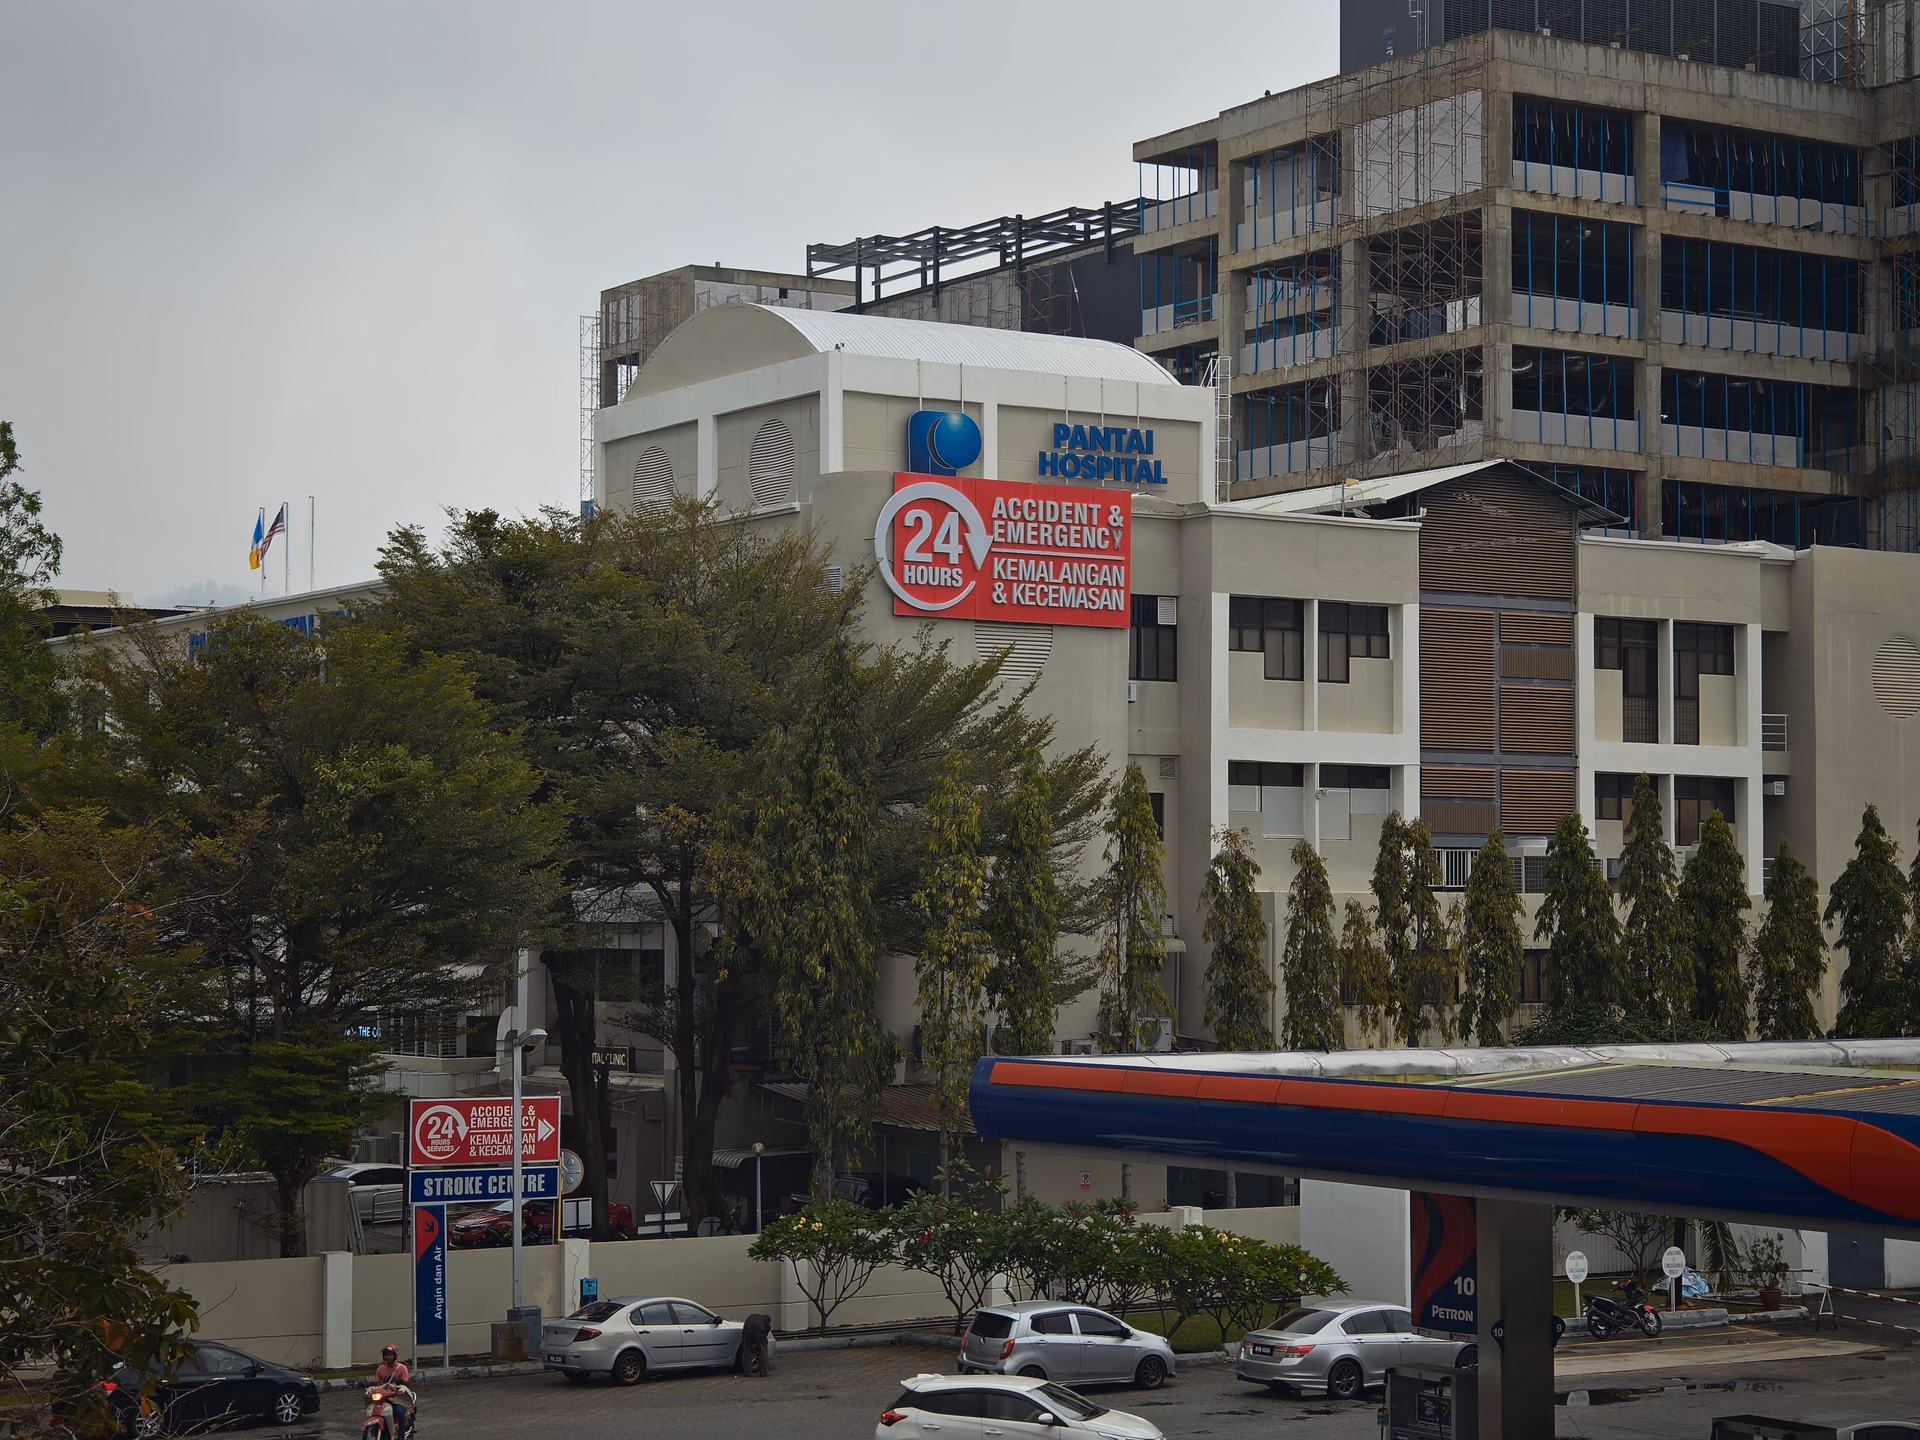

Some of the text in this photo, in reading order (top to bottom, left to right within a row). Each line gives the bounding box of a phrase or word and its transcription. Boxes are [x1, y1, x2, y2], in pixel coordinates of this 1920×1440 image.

[1053, 422, 1154, 455] PANTAI
[1038, 451, 1168, 485] HOSPITAL
[991, 496, 1125, 528] ACCIDENT &
[903, 508, 964, 565] 24
[992, 520, 1125, 551] EMERGENCY
[903, 564, 964, 588] HOURS
[991, 557, 1125, 588] KEMALANGAN
[991, 582, 1125, 612] & KECEMASAN
[527, 1105, 536, 1116] &
[427, 1115, 455, 1140] 24
[470, 1116, 536, 1129] EMERGECY
[426, 1145, 455, 1153] SERVICES
[430, 1138, 451, 1146] HOURS
[469, 1133, 536, 1146] KEMALANAN
[469, 1146, 477, 1157] &
[423, 1176, 483, 1197] STROKE
[433, 1245, 445, 1320] Angin dan Air
[1453, 1276, 1475, 1296] 10
[1431, 1304, 1474, 1322] PETRON
[1492, 1327, 1504, 1337] 10
[1556, 1323, 1562, 1333] 9
